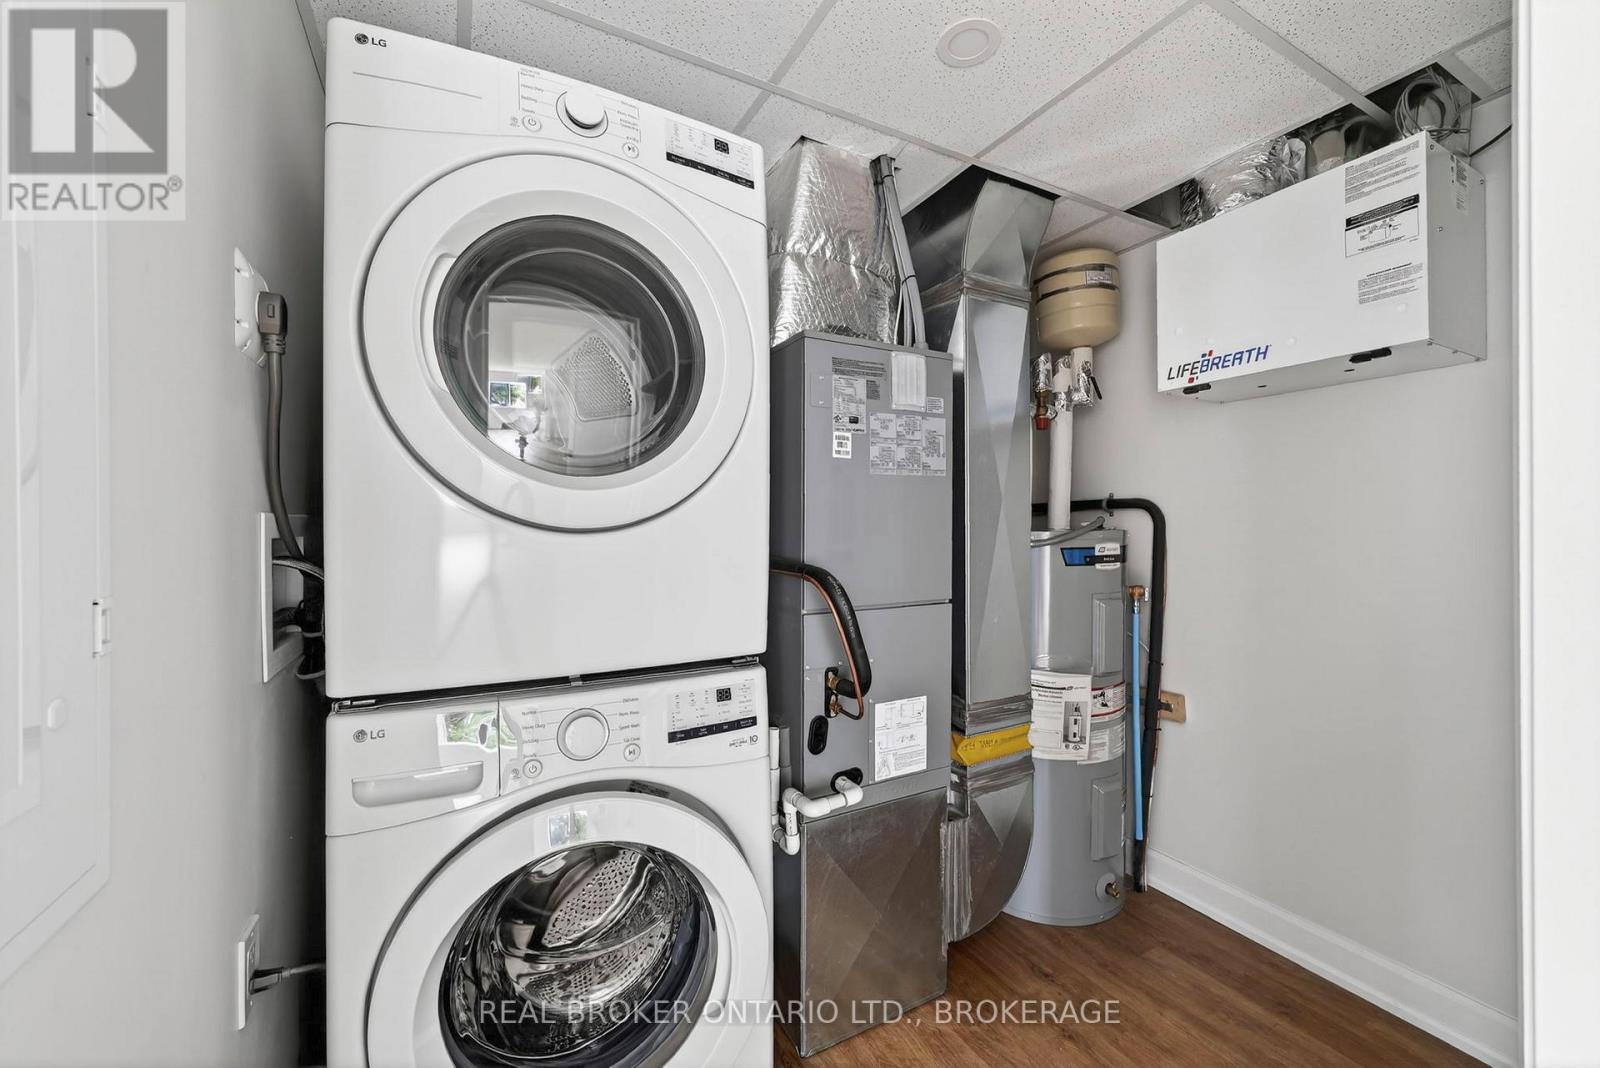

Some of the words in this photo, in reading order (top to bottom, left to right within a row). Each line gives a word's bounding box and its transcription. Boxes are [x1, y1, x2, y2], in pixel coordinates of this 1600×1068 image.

[371, 37, 387, 47] LG
[1167, 344, 1269, 380] LIFEBREATH
[370, 729, 385, 739] LG
